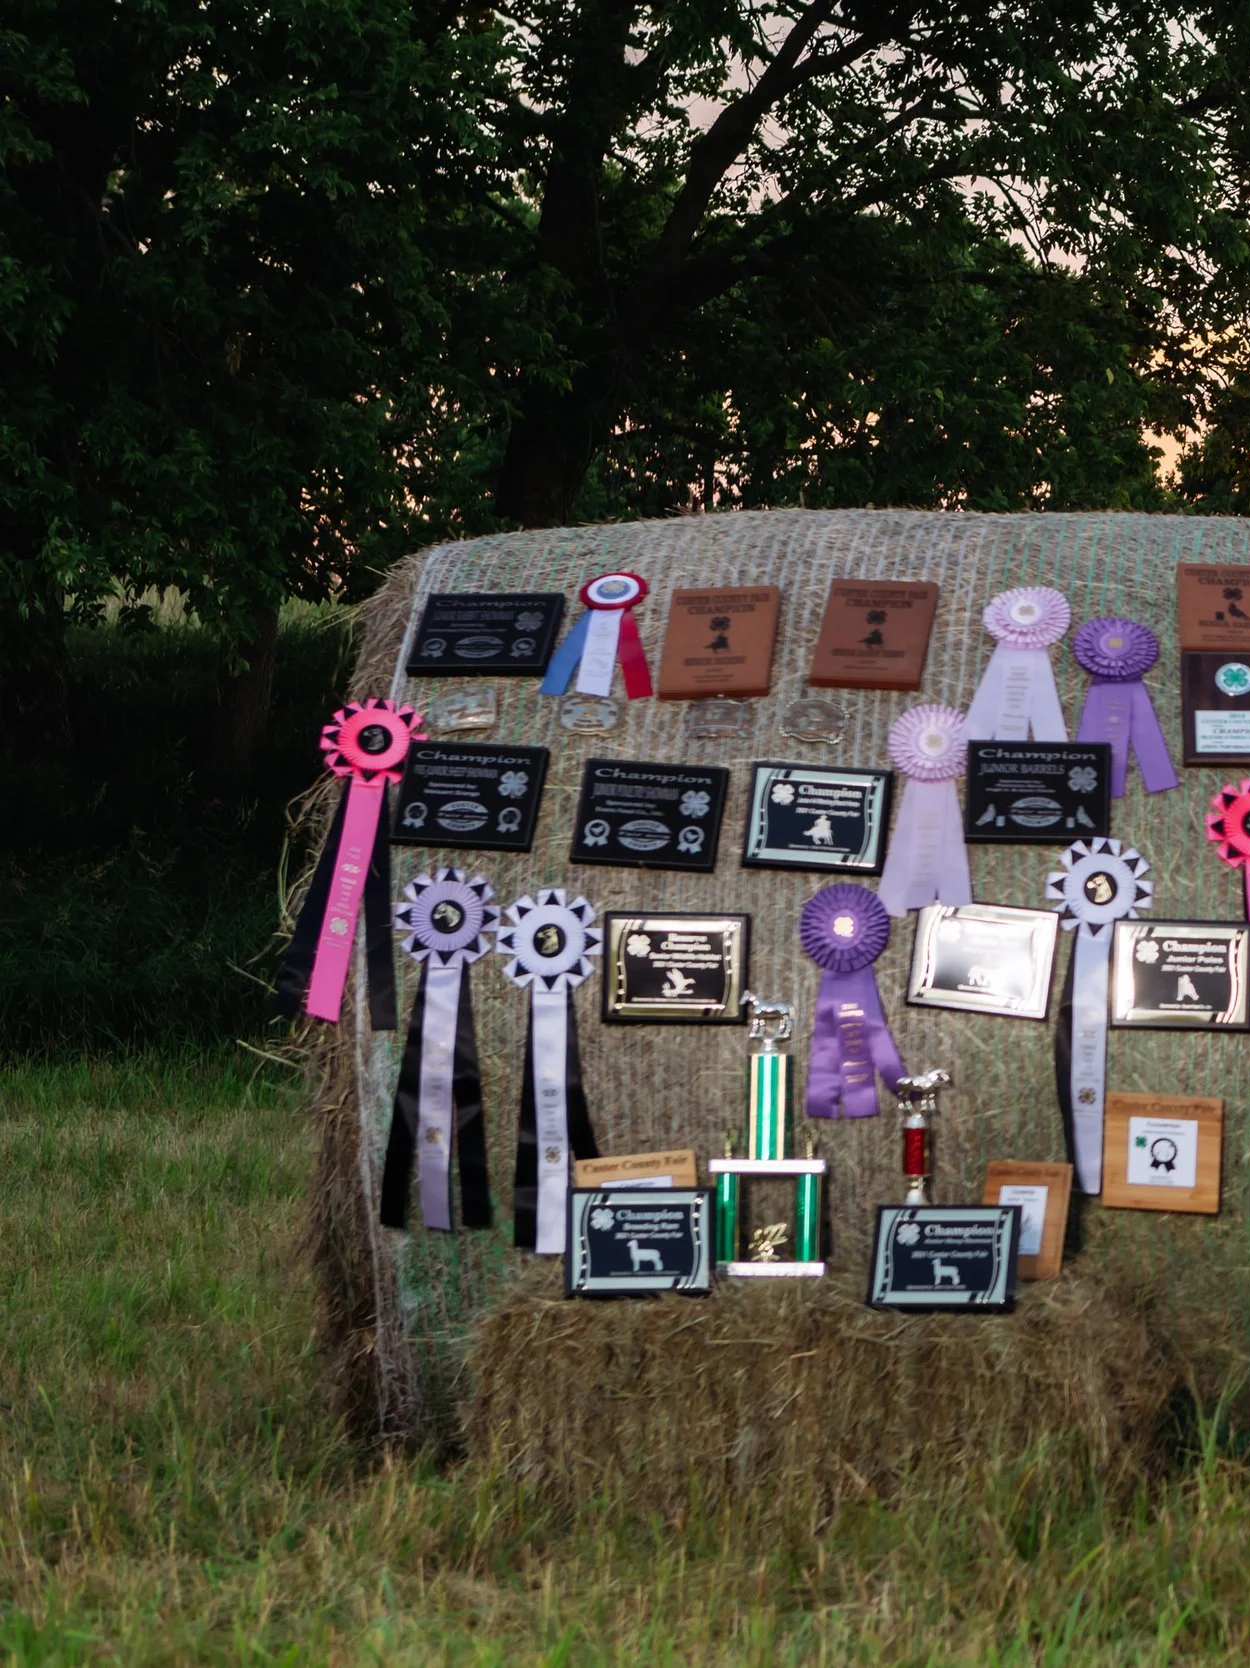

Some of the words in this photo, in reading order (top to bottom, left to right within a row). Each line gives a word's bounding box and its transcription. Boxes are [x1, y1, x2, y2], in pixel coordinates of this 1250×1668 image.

[435, 599, 547, 607] Champion
[416, 750, 532, 765] Champion
[977, 748, 1097, 761] Champion
[594, 768, 713, 784] Champion
[977, 762, 1019, 776] JUNIOR
[1020, 763, 1065, 774] BARRELS
[798, 784, 862, 799] Champion
[660, 941, 712, 953] Champion
[1162, 940, 1227, 955] Champion
[582, 1163, 619, 1173] Custer
[621, 1159, 661, 1171] County
[664, 1156, 689, 1166] Fair
[615, 1209, 684, 1223] Champion
[924, 1224, 995, 1238] Champion
